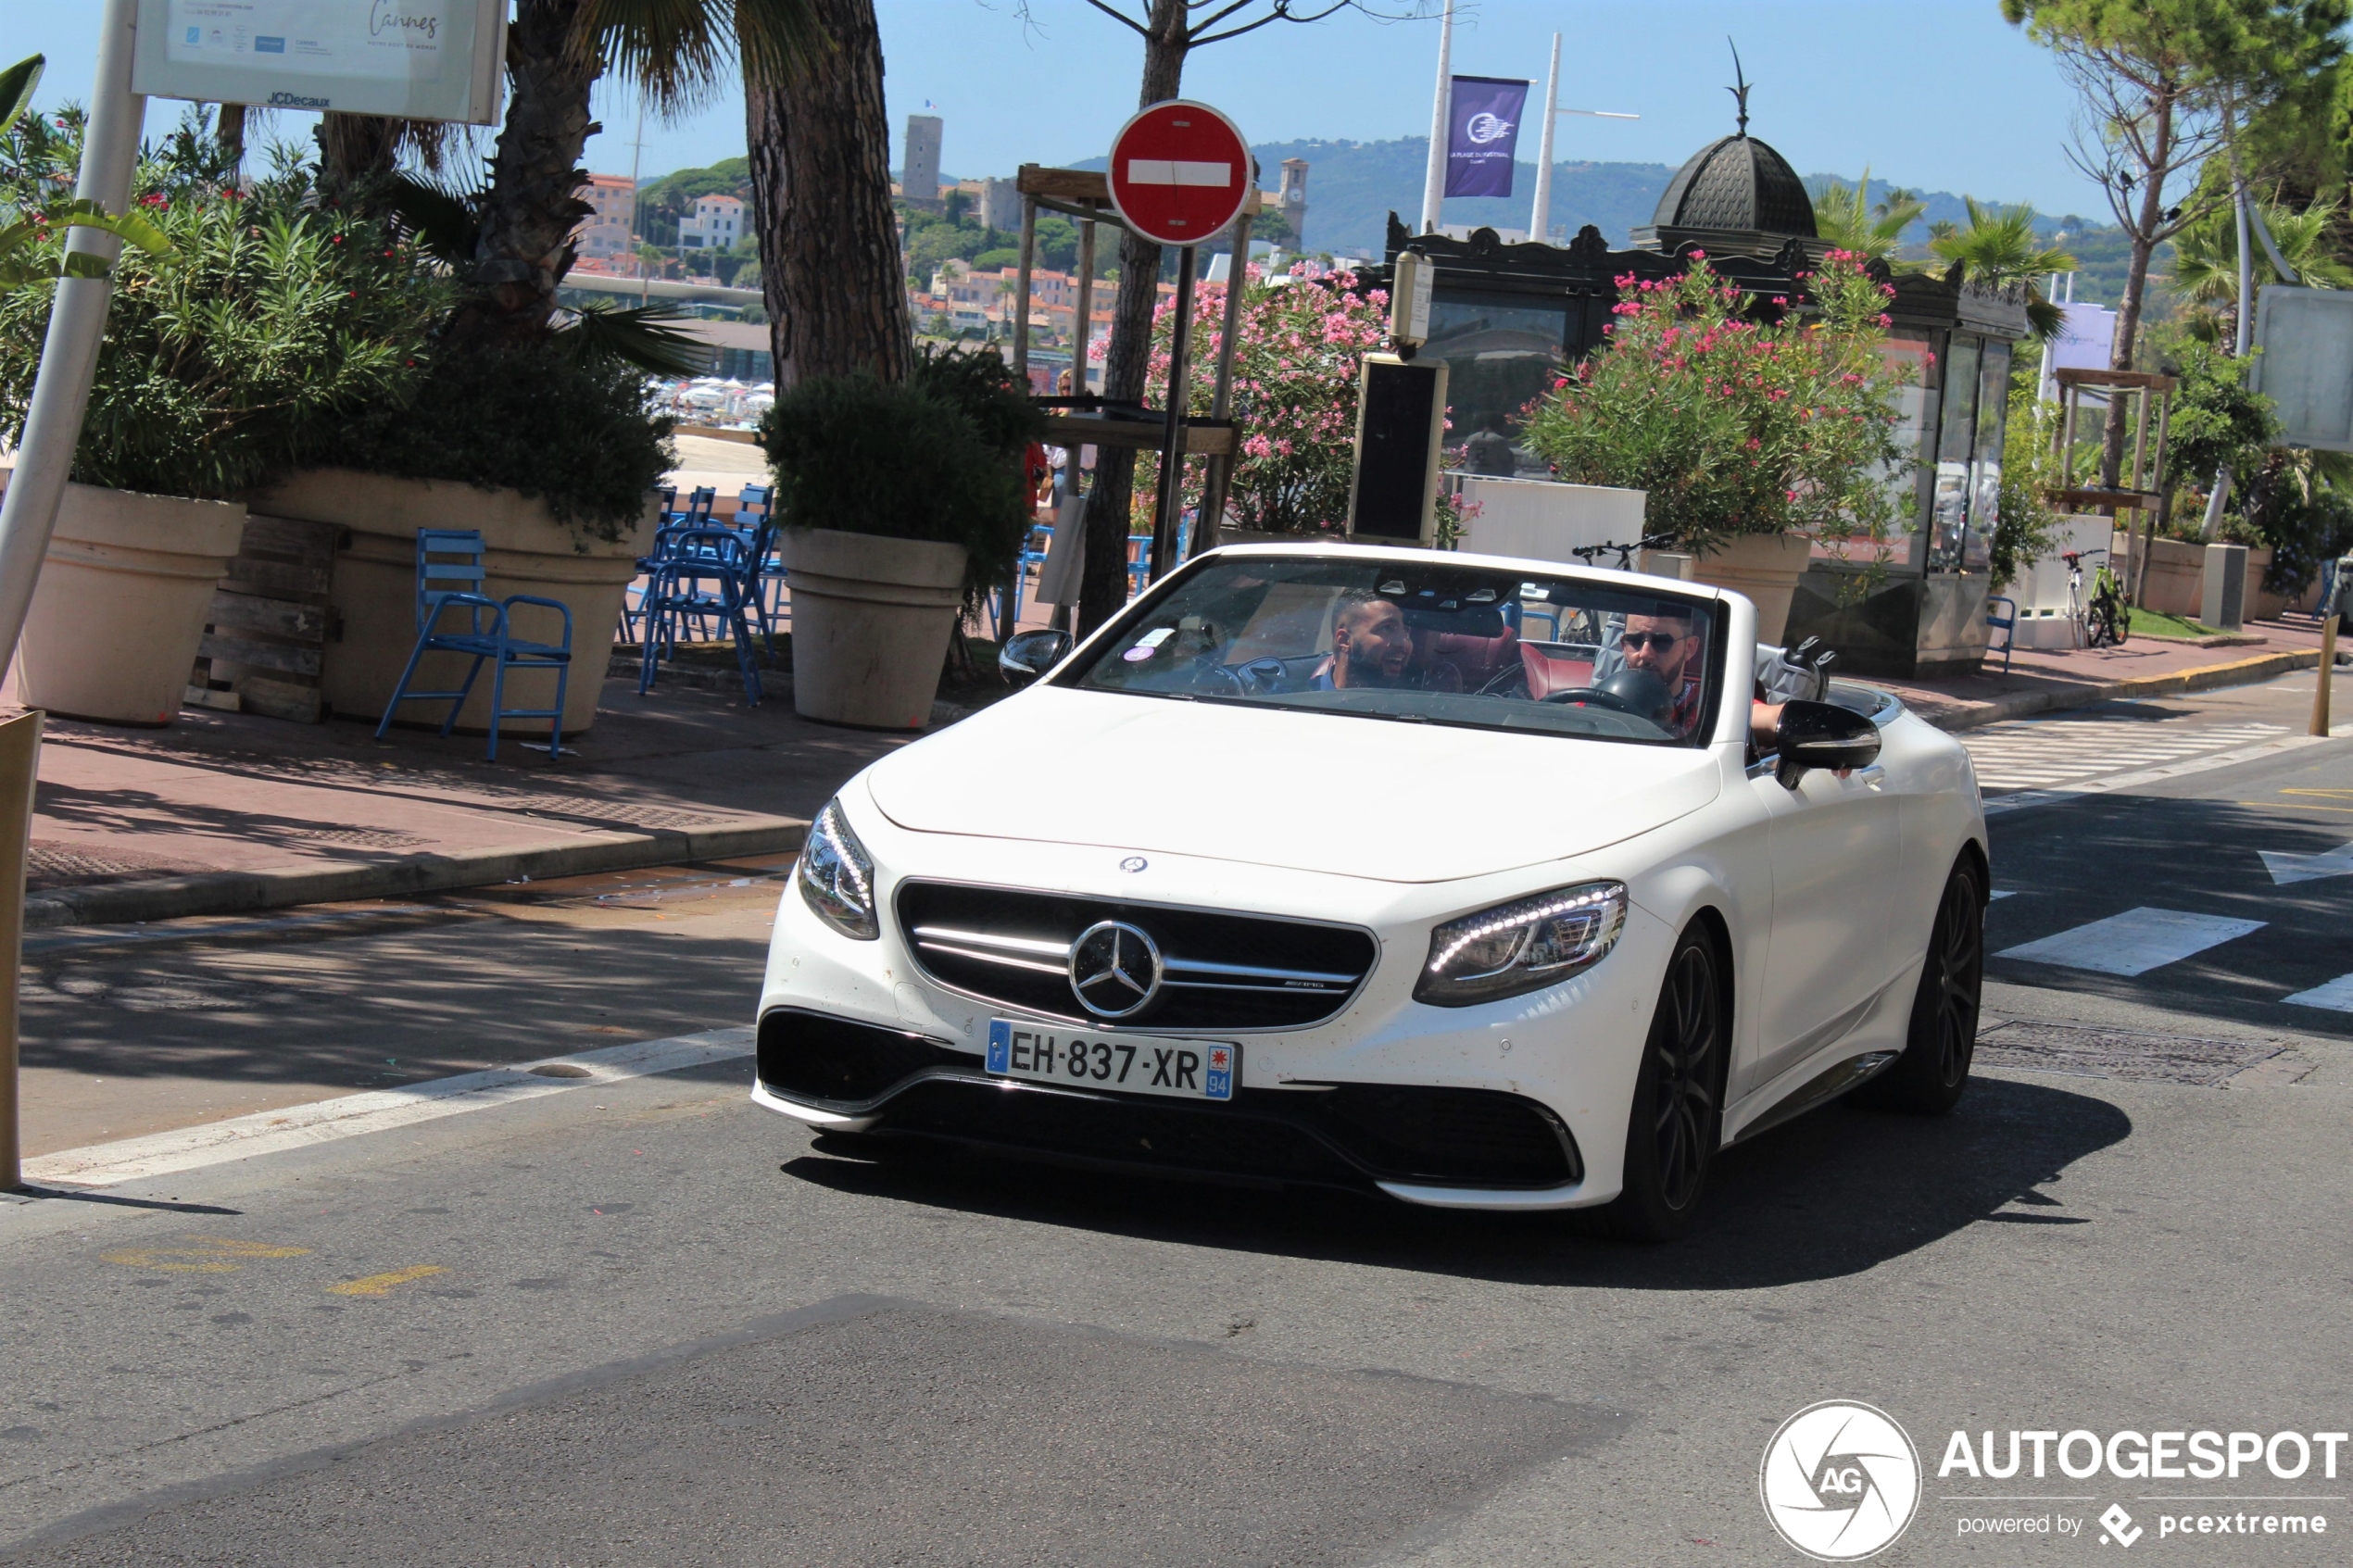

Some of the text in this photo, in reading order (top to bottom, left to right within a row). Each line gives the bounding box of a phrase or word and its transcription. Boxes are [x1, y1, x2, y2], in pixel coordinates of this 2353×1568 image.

[267, 92, 330, 107] JCDecaux
[994, 1051, 1001, 1062] F
[1011, 1031, 1201, 1090] EH-837-XR
[1208, 1075, 1227, 1093] 94
